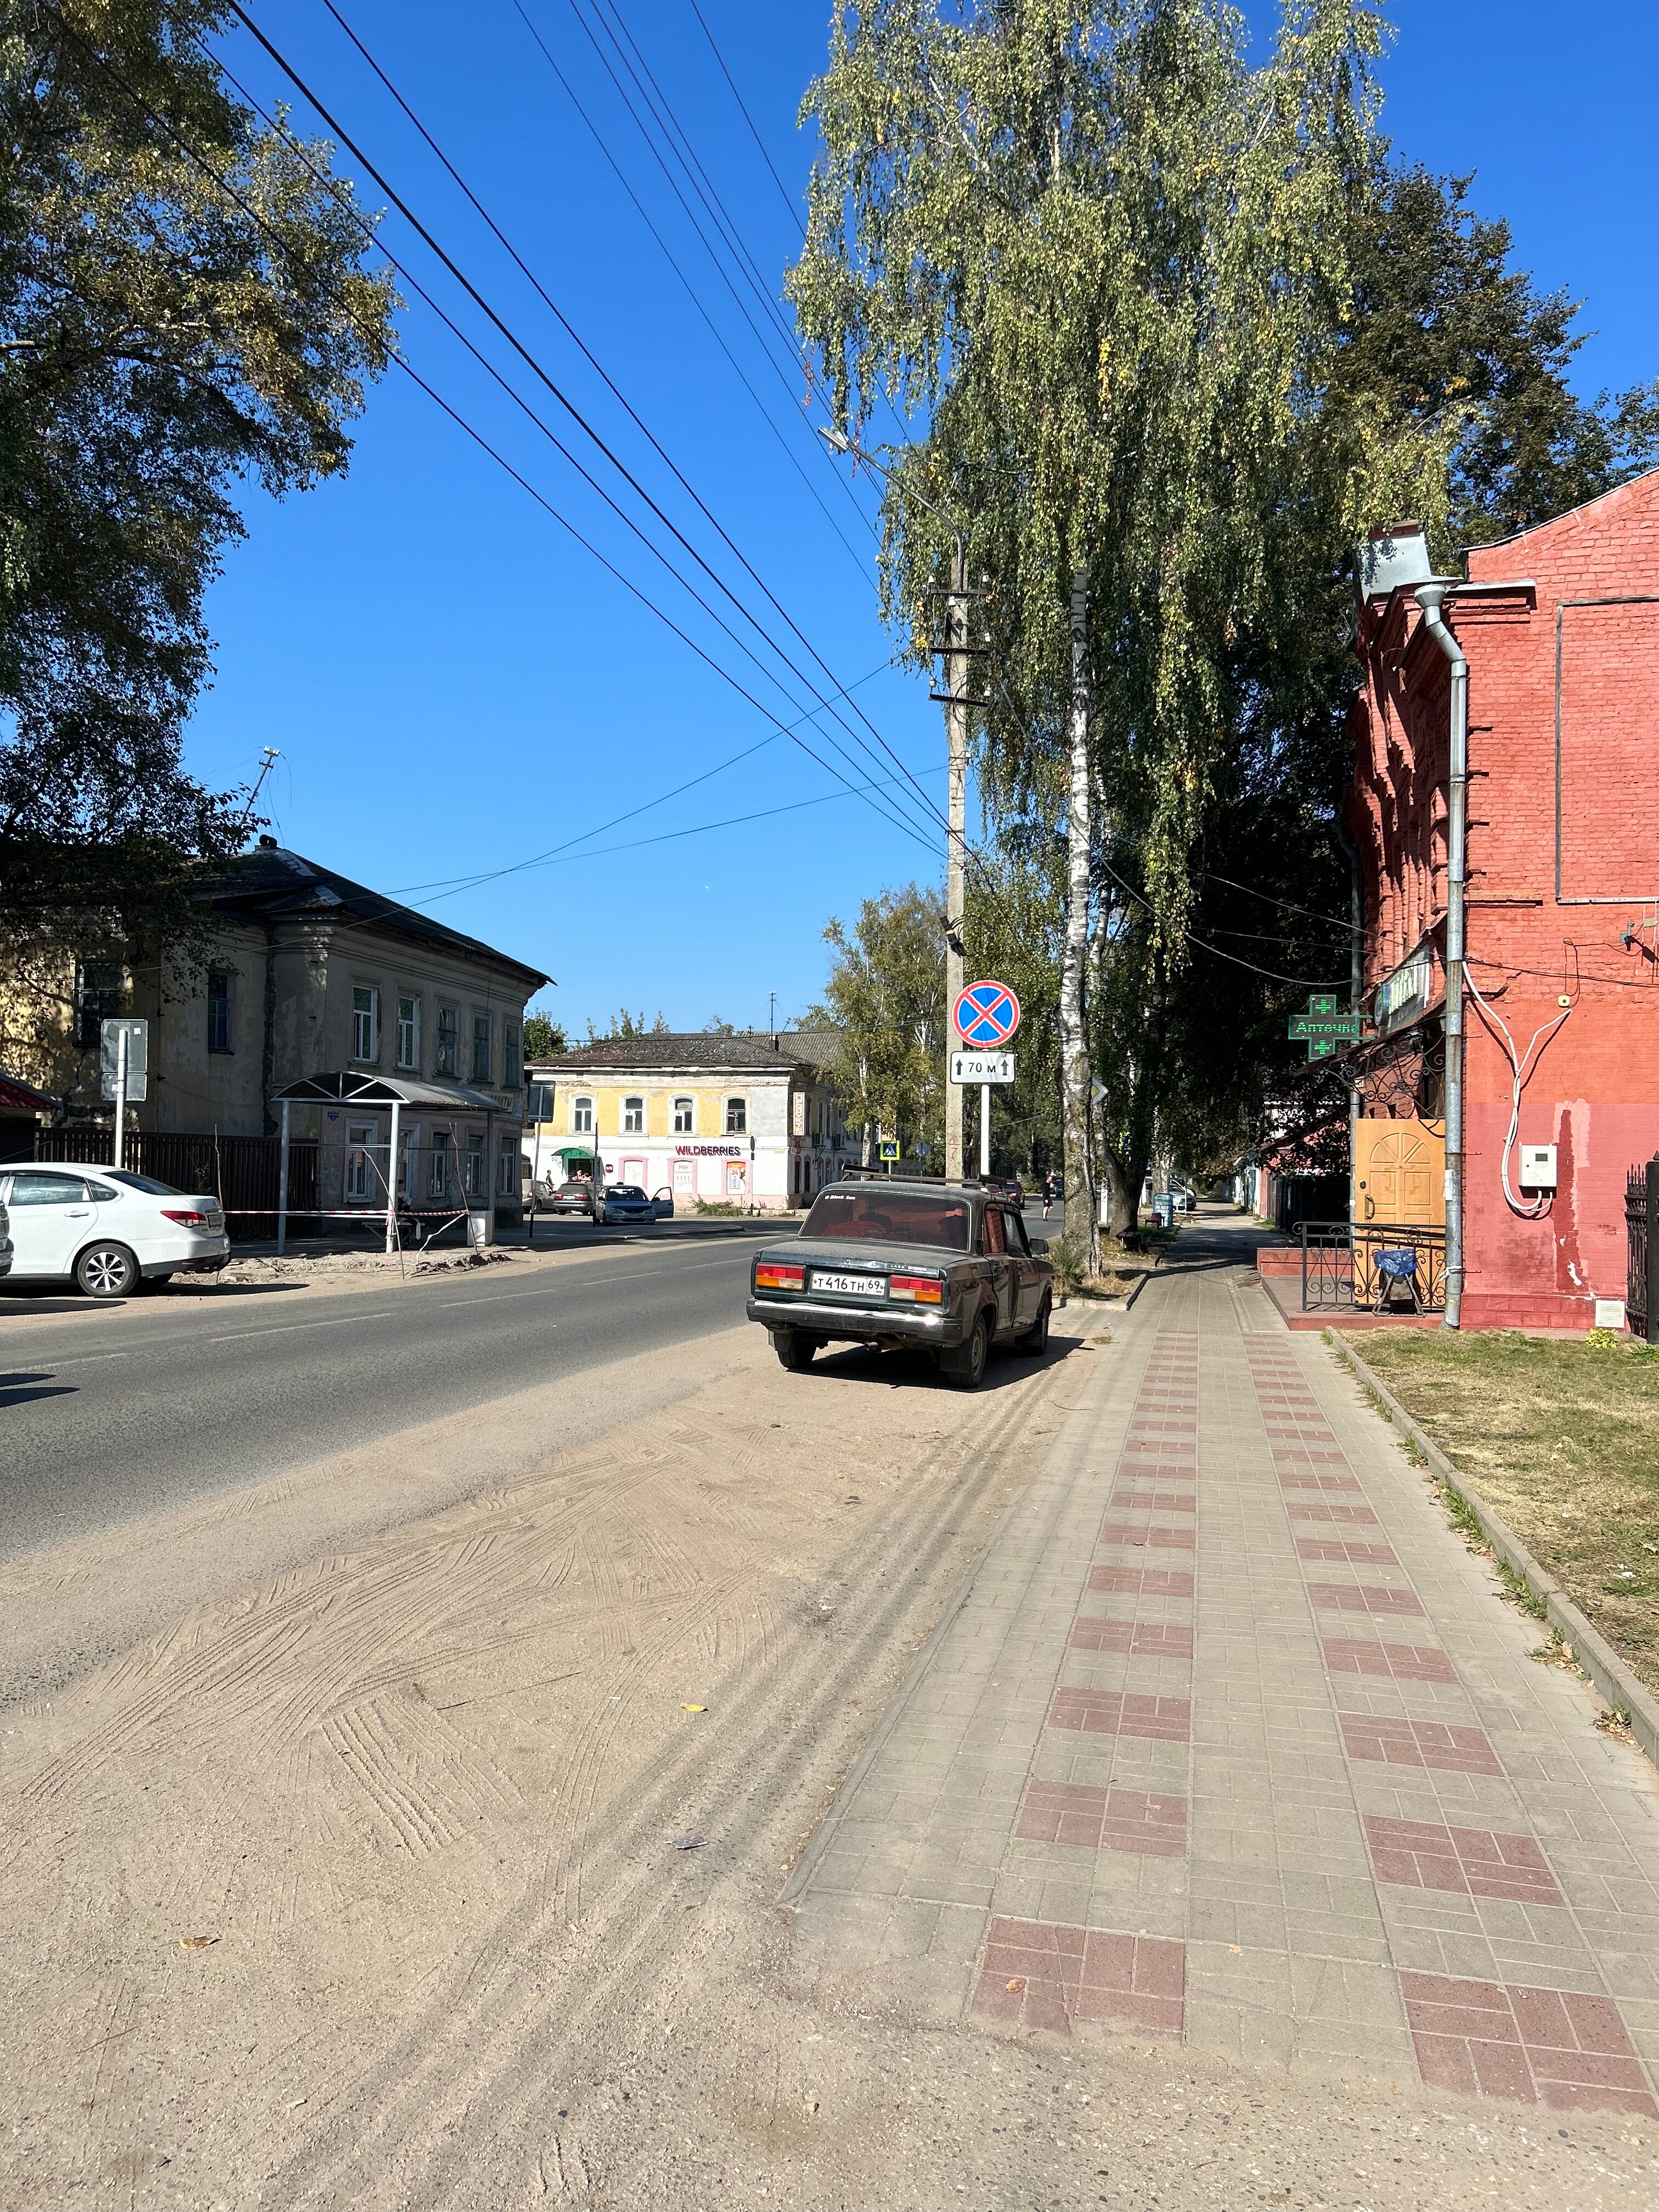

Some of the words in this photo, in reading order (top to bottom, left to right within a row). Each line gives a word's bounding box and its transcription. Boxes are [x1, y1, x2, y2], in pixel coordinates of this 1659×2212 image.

[968, 1062, 982, 1073] 70
[675, 1146, 741, 1156] WILDBERRIES
[868, 1280, 880, 1290] 69
